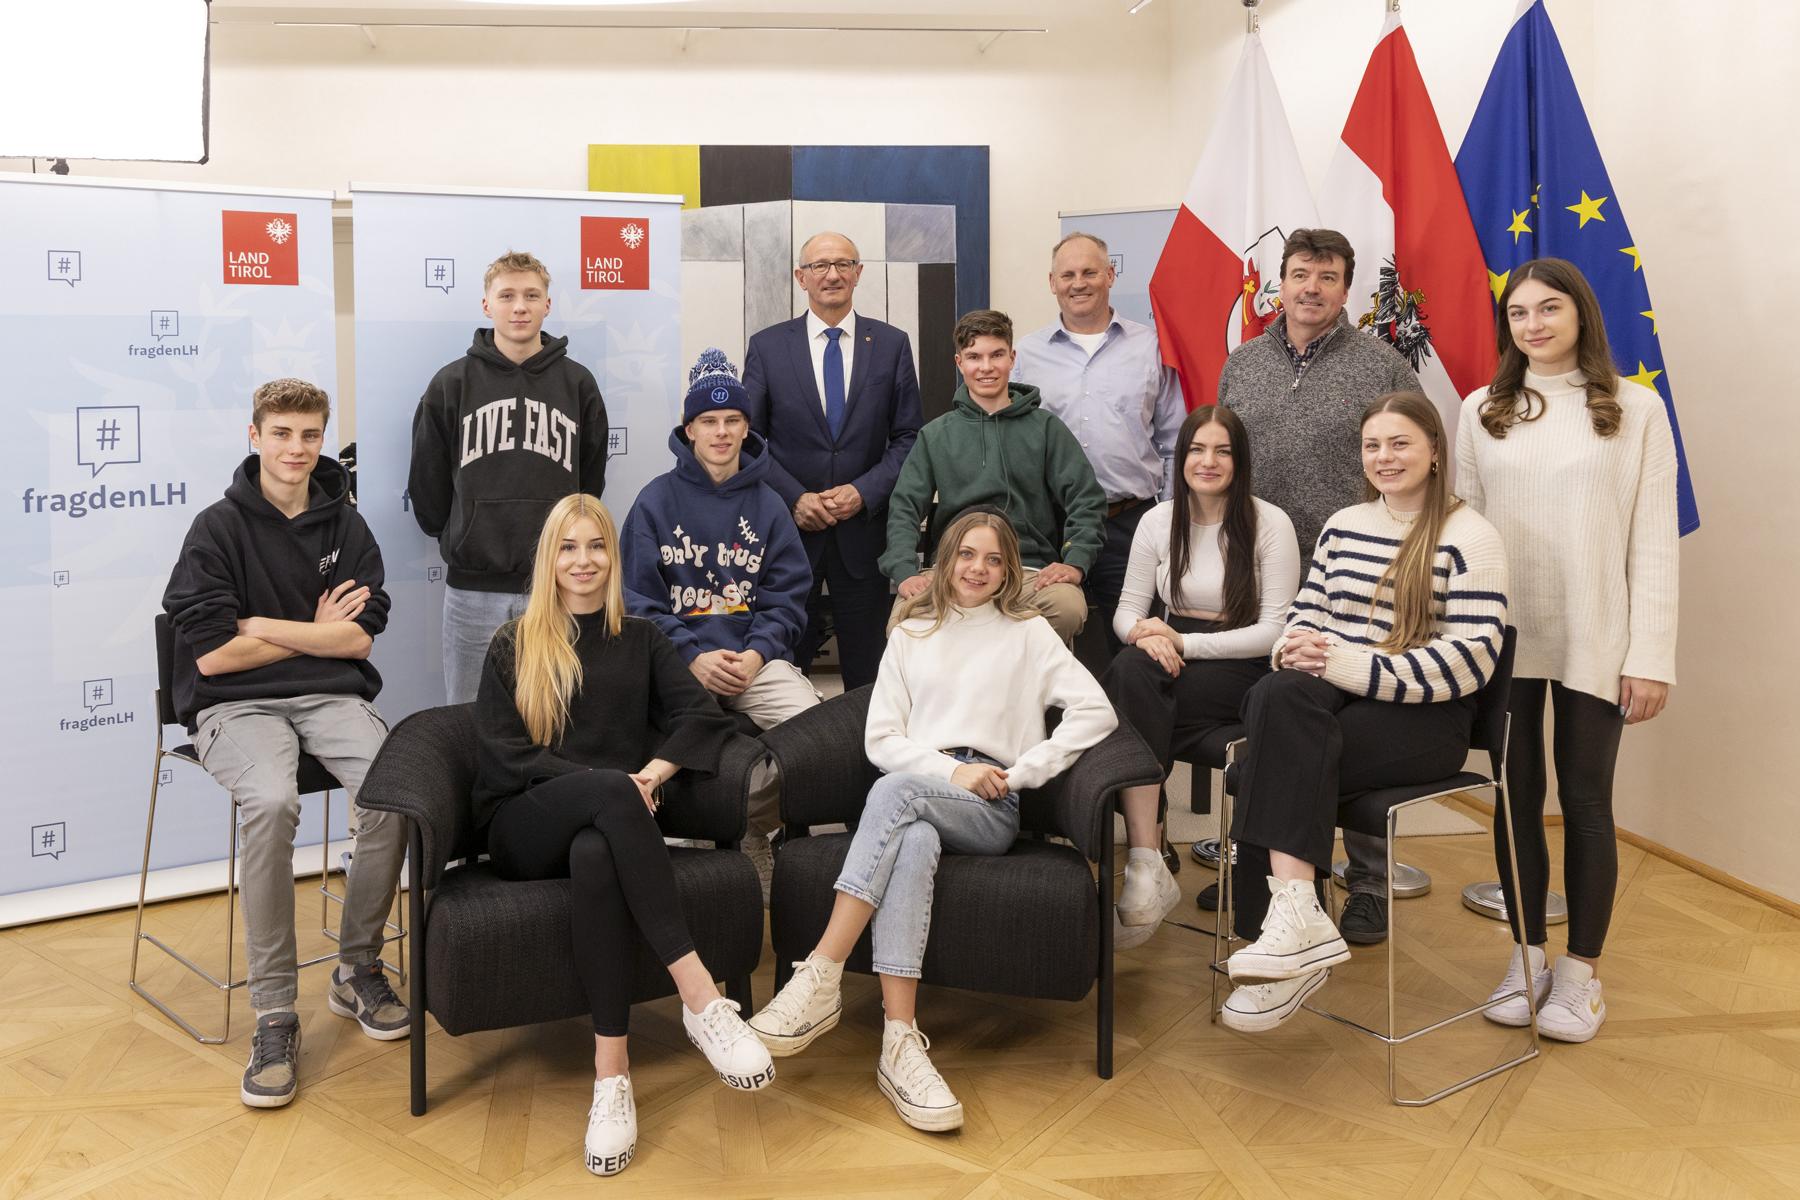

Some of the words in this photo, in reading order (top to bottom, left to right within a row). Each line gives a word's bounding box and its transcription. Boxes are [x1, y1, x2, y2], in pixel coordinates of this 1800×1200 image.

[229, 251, 270, 265] LAND
[586, 256, 623, 270] LAND
[228, 265, 272, 279] TIROL
[586, 270, 625, 283] TIROL
[128, 344, 199, 359] fragdenLH
[460, 397, 517, 469] LIVE
[522, 397, 577, 473] FAST
[22, 482, 187, 519] fragdenLH
[59, 711, 134, 732] fragdenLH
